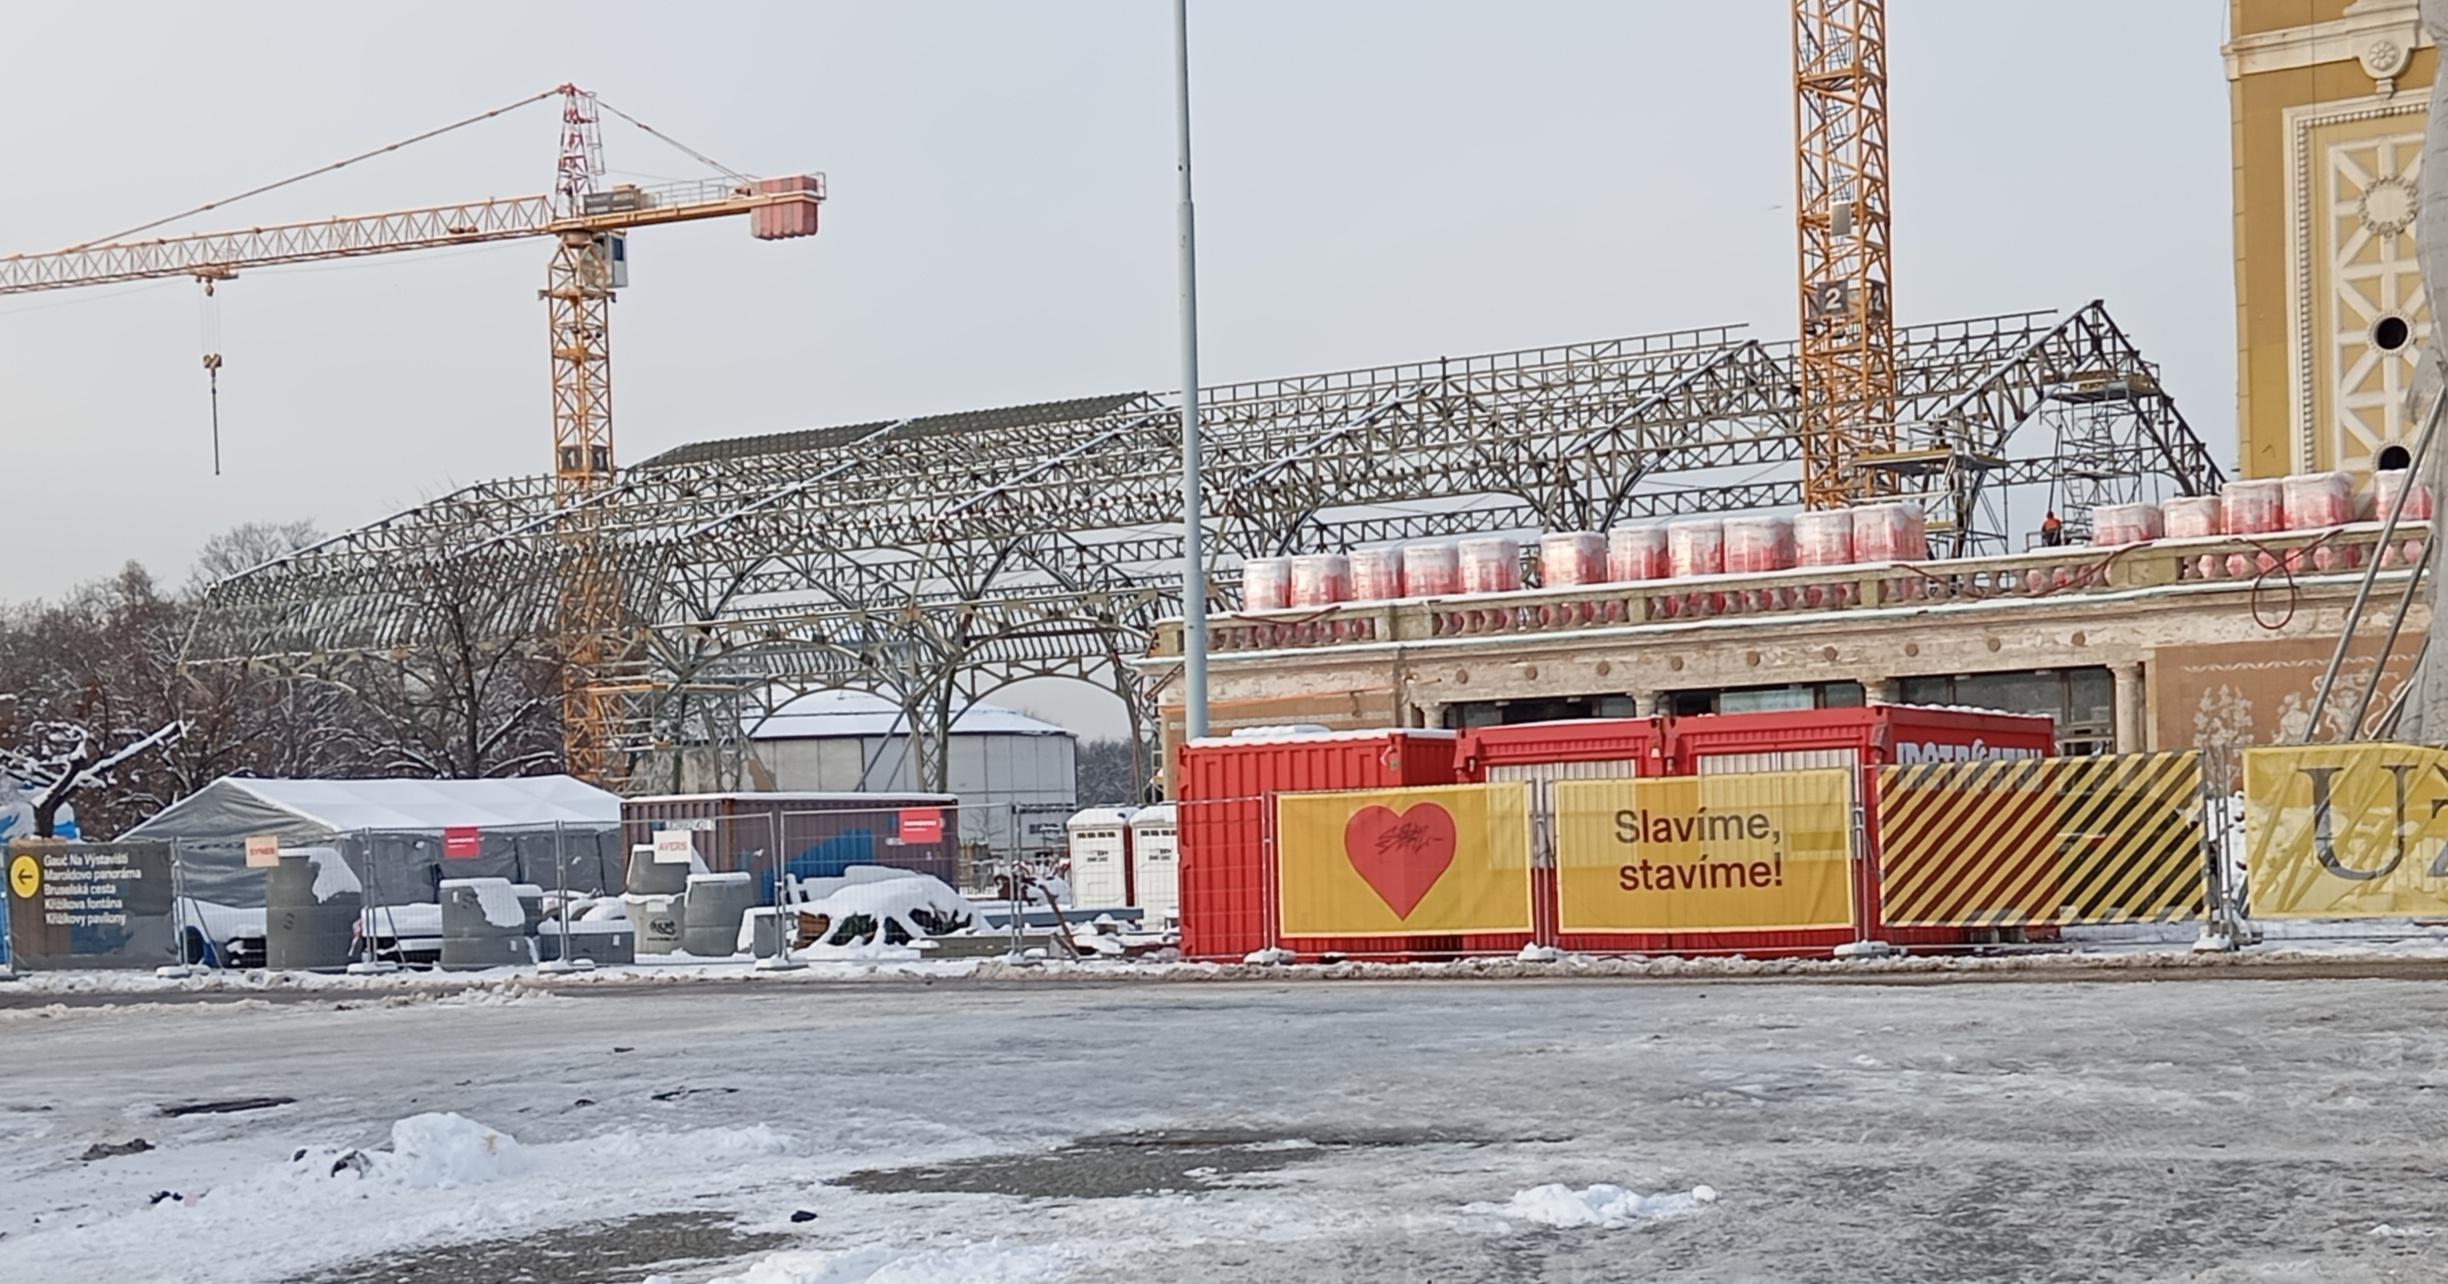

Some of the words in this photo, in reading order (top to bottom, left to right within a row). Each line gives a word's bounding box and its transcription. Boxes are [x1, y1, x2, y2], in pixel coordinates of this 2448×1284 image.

[1825, 286, 1842, 310] 2
[568, 450, 575, 468] 1
[596, 451, 603, 468] 1
[1615, 806, 1780, 844] Slavíme,
[69, 854, 83, 866] Na
[43, 868, 92, 881] Maroldovo
[93, 867, 142, 881] panoráma
[1619, 852, 1783, 890] stavíme!
[43, 883, 89, 896] Bruselská
[90, 883, 117, 894] cesta
[87, 896, 123, 909] fontána
[87, 911, 127, 927] pavilony
